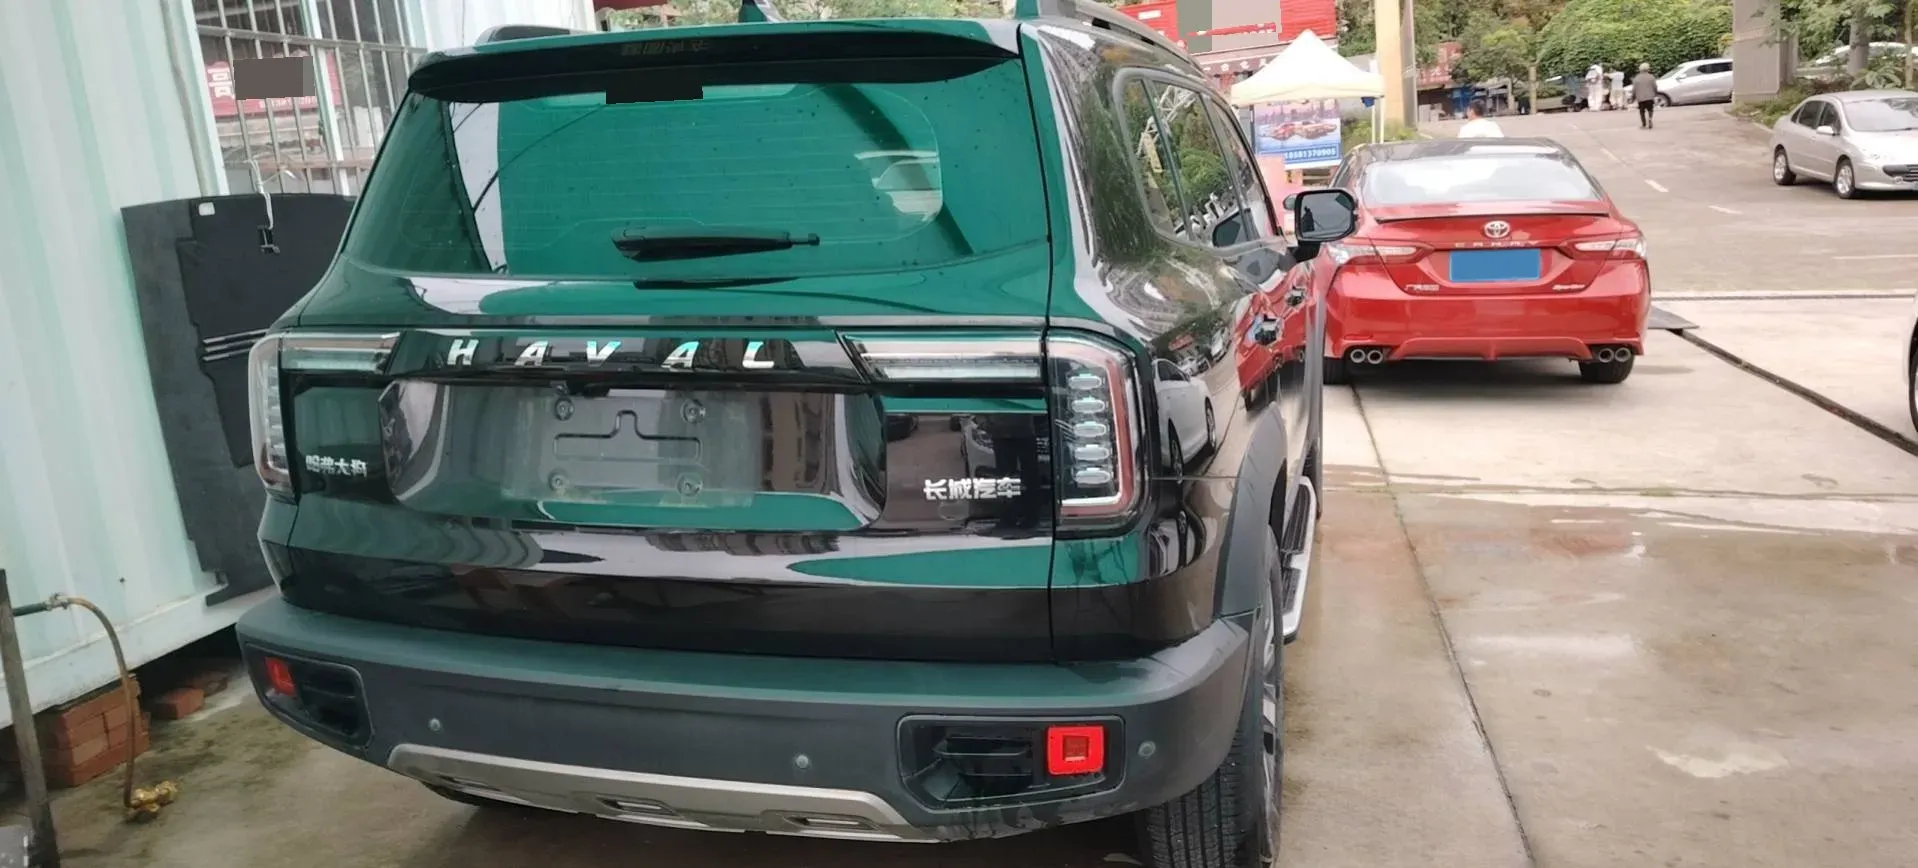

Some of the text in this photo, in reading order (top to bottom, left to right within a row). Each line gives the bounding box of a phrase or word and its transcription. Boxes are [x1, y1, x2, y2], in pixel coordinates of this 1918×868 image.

[446, 338, 775, 370] HAVAL
[305, 454, 368, 479] 哈弗大狗
[923, 476, 1022, 501] 长城汽车
